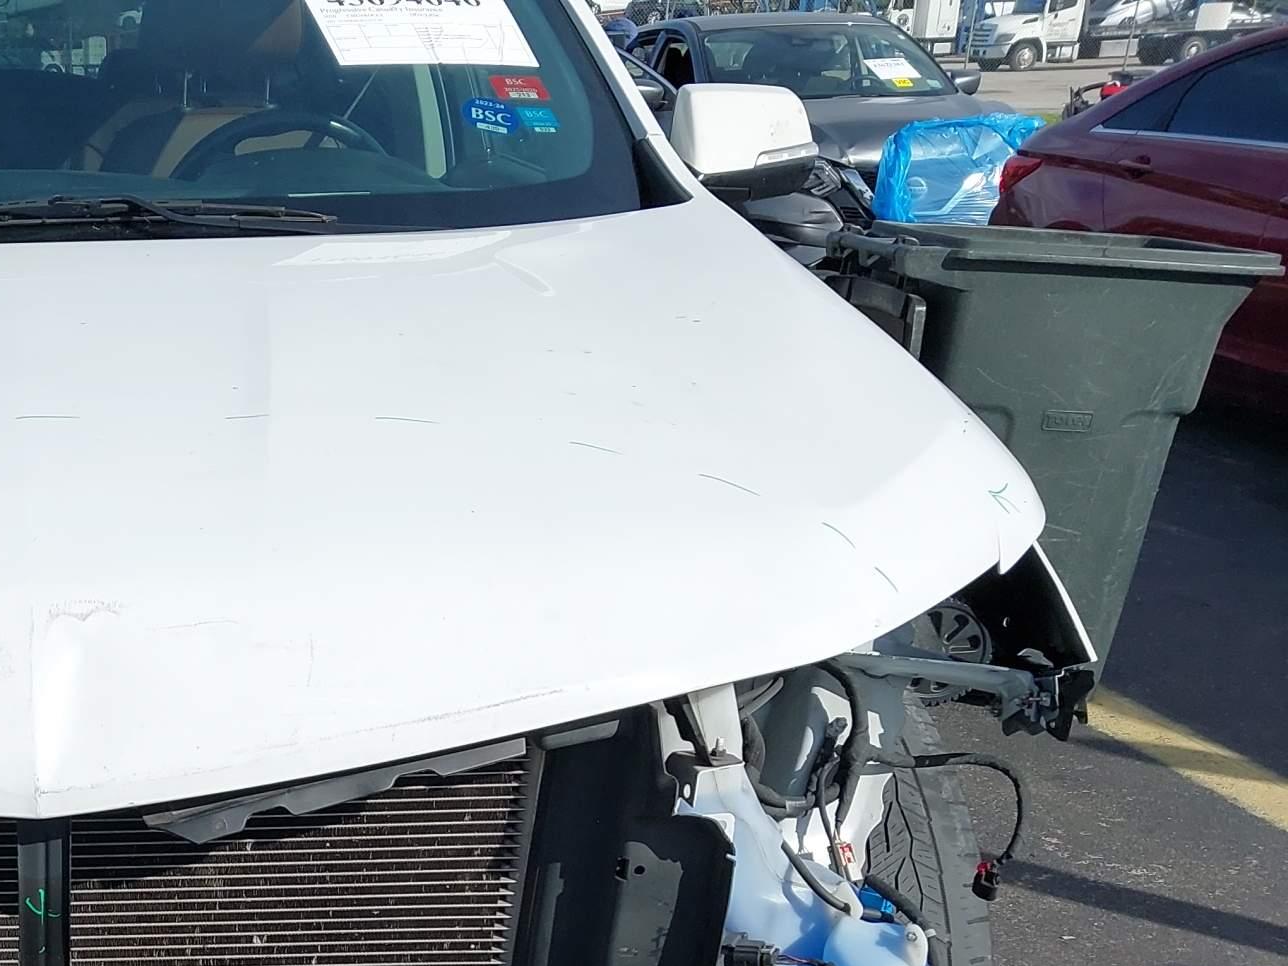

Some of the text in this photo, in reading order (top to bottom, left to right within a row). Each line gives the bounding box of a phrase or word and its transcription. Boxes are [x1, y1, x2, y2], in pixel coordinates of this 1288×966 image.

[504, 78, 527, 86] BSC
[471, 106, 512, 126] BSC
[524, 110, 547, 119] BSC
